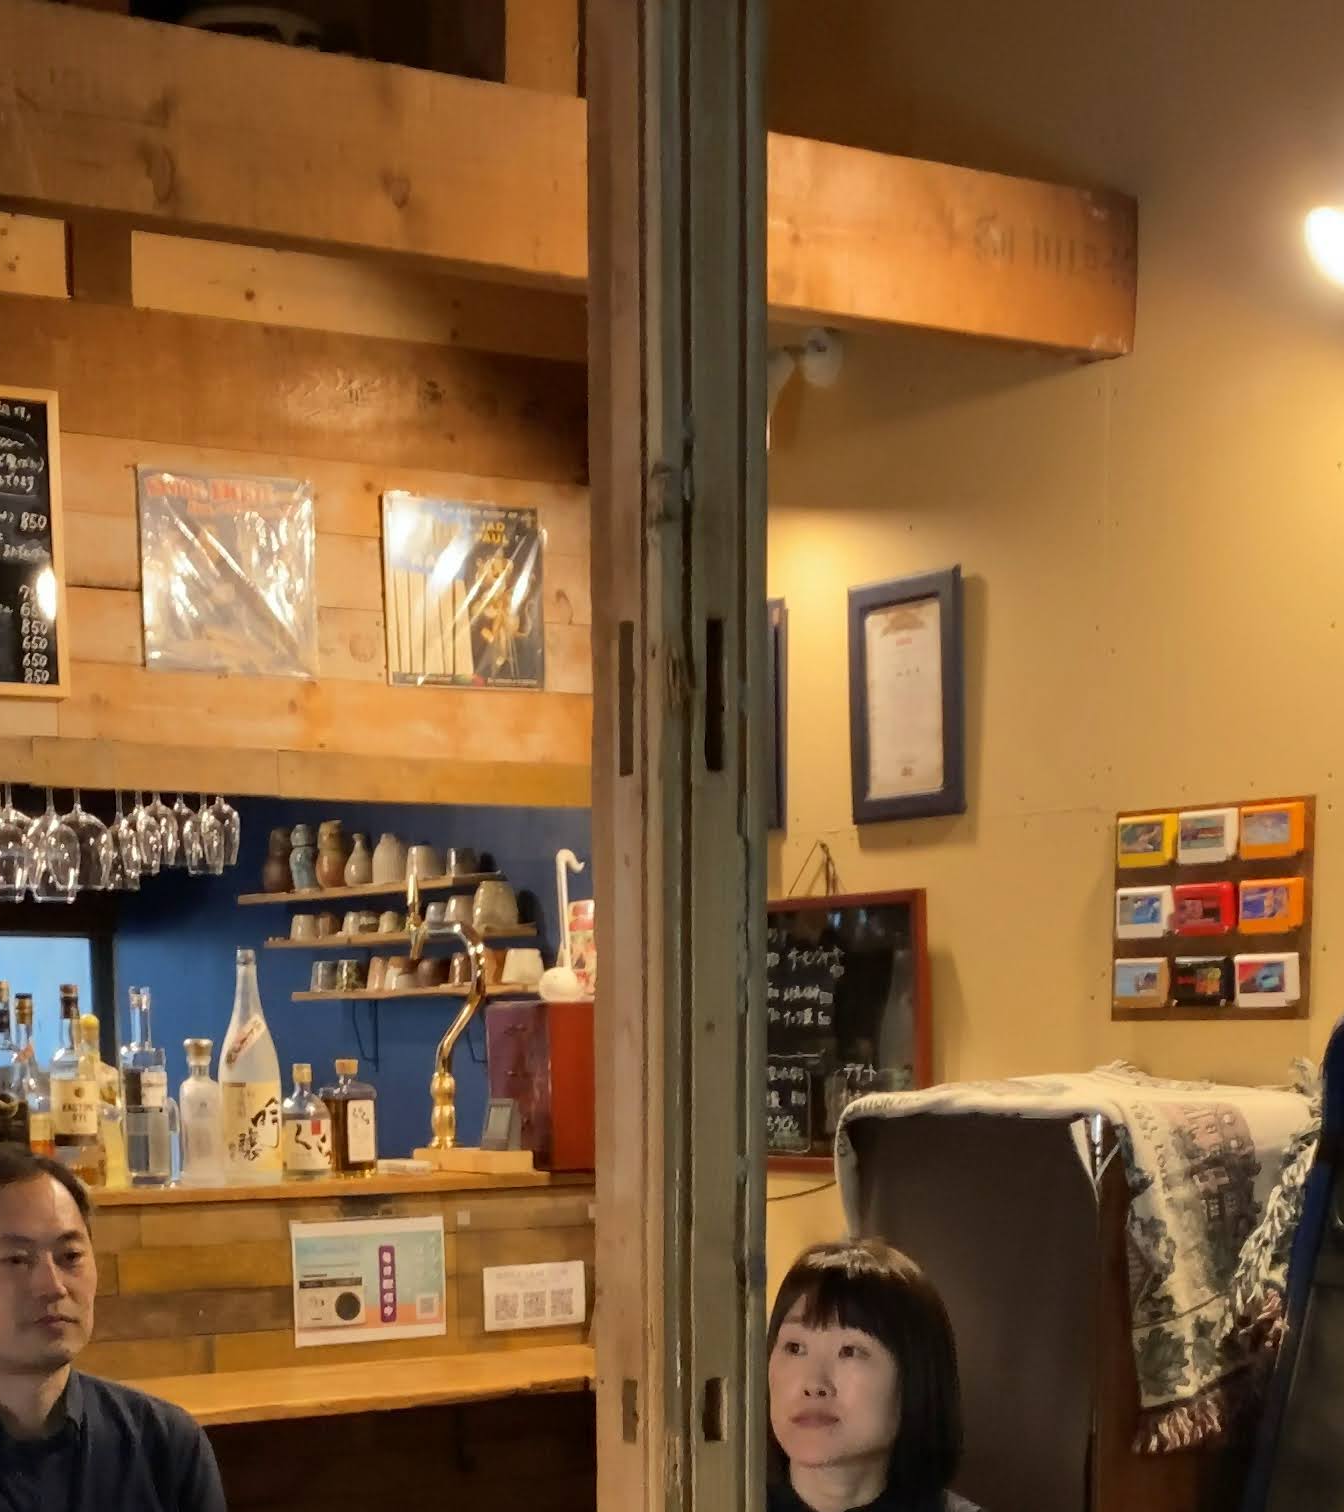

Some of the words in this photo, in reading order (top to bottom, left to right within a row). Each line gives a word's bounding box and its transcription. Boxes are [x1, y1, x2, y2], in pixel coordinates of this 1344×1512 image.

[20, 511, 47, 531] 850
[21, 618, 49, 635] 850
[22, 635, 49, 650] 650
[22, 655, 49, 669] 650
[23, 666, 50, 684] 850
